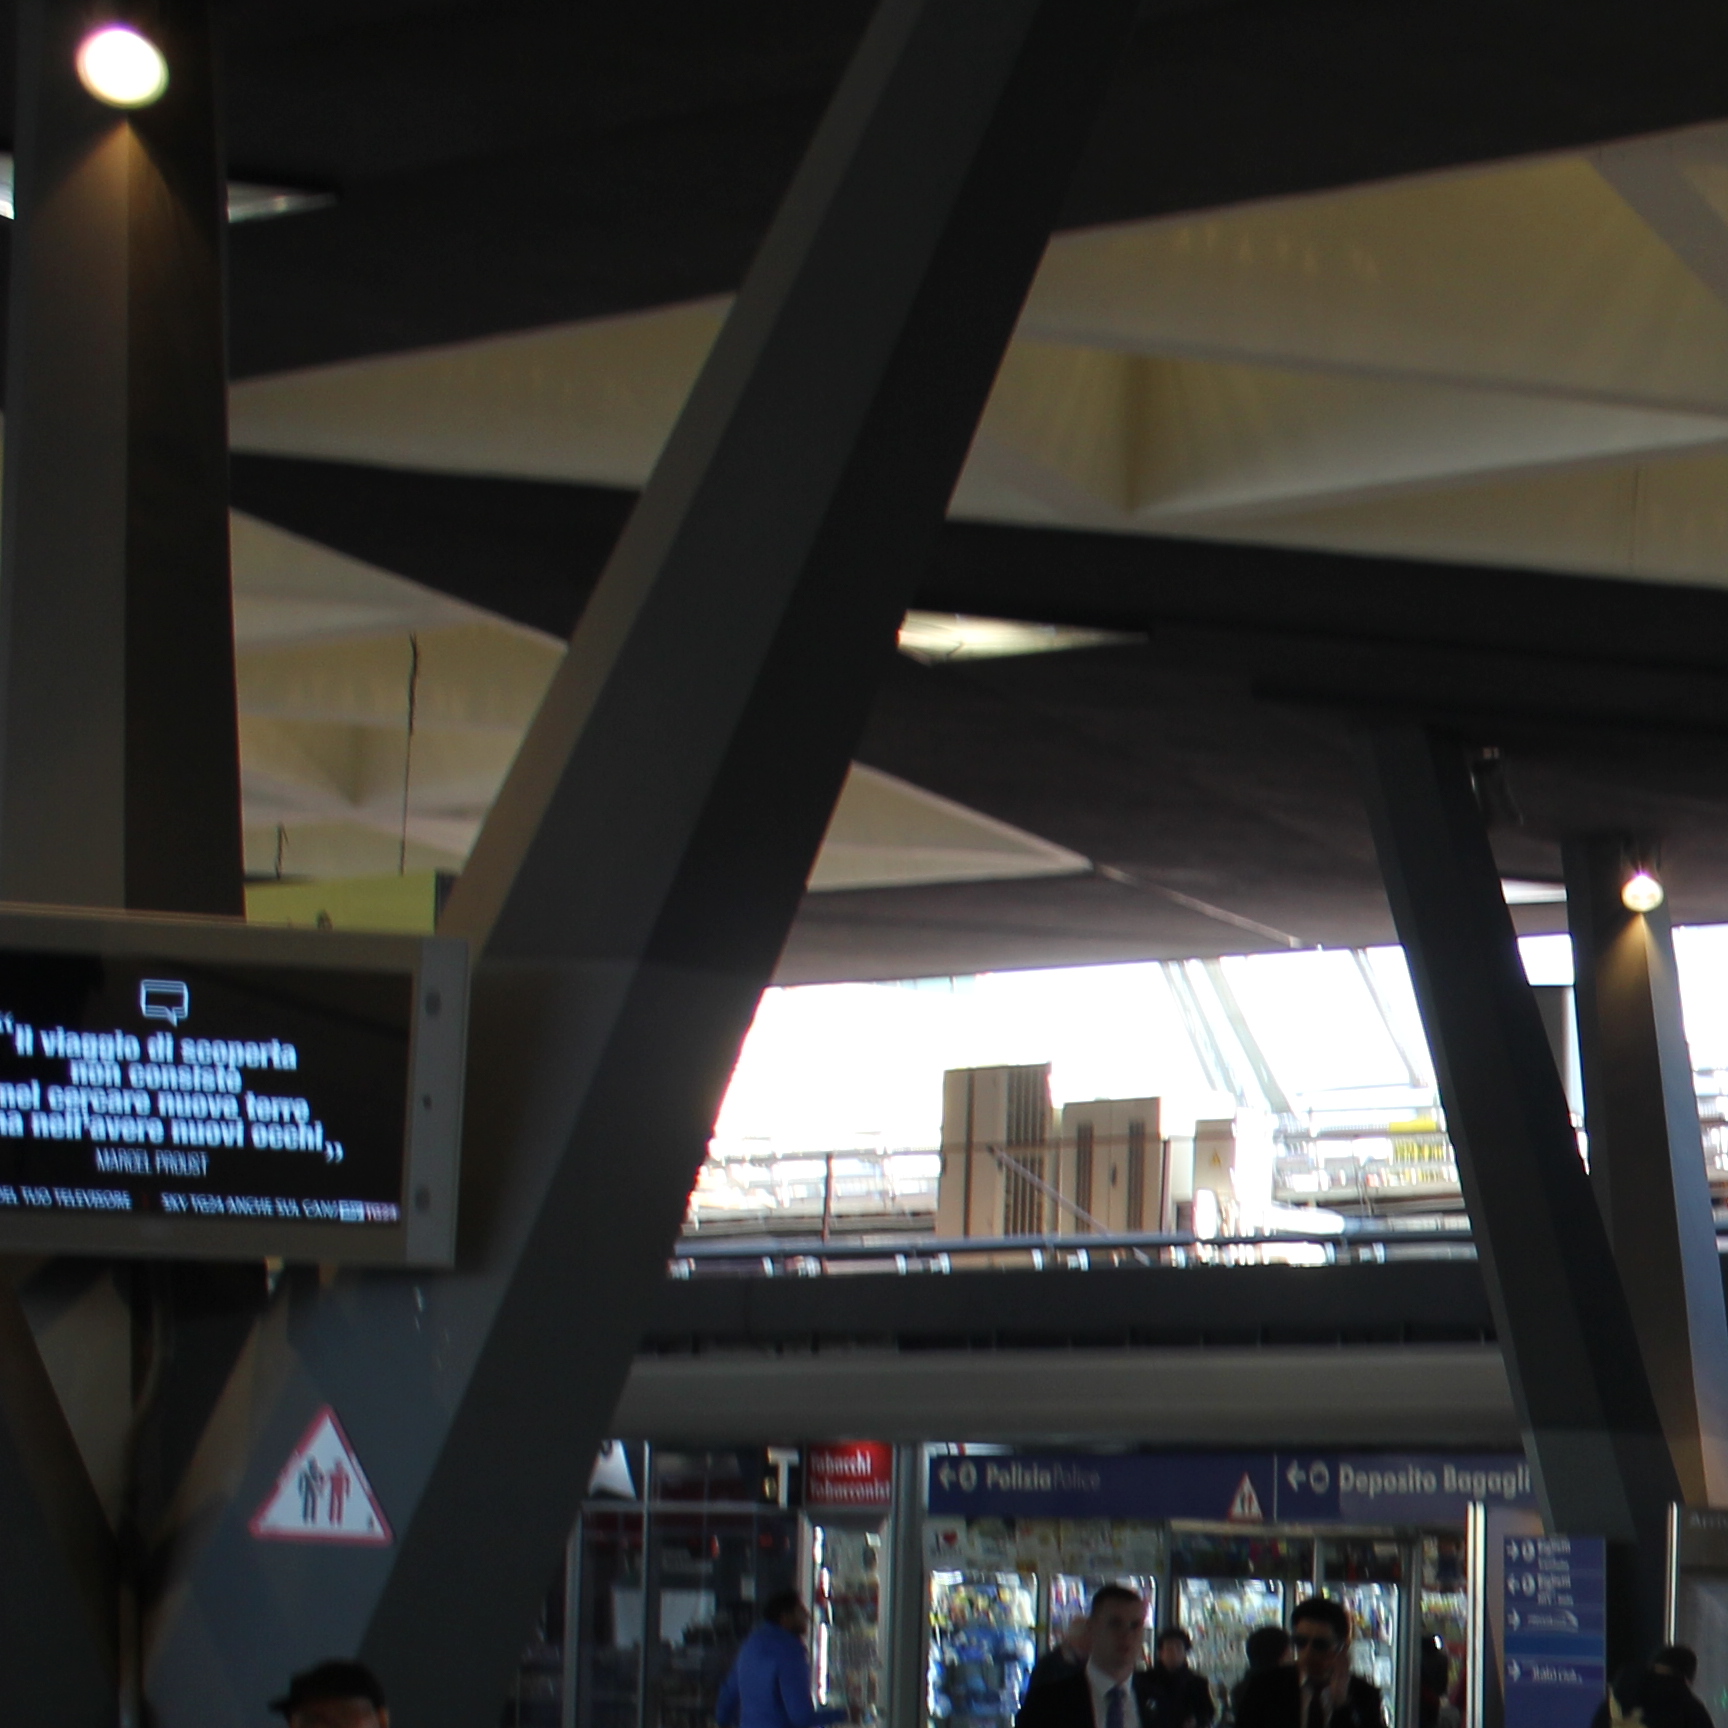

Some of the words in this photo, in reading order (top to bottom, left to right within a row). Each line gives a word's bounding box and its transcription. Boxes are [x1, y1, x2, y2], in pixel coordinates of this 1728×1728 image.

[40, 1025, 141, 1064] viaggio
[147, 1031, 175, 1064] di
[180, 1035, 298, 1073] scoperta
[70, 1058, 122, 1088] non
[128, 1061, 243, 1094] consiste
[47, 1084, 152, 1116] cercare
[157, 1089, 240, 1122] nuove
[245, 1090, 311, 1124] terre
[170, 1116, 245, 1148] nuovi
[95, 1147, 152, 1176] MARCEL
[155, 1149, 209, 1178] PROUST
[985, 1463, 1052, 1492] Polizia
[1053, 1464, 1101, 1491] Police
[1338, 1462, 1438, 1498] Deposito
[1442, 1461, 1531, 1498] Bagagli
